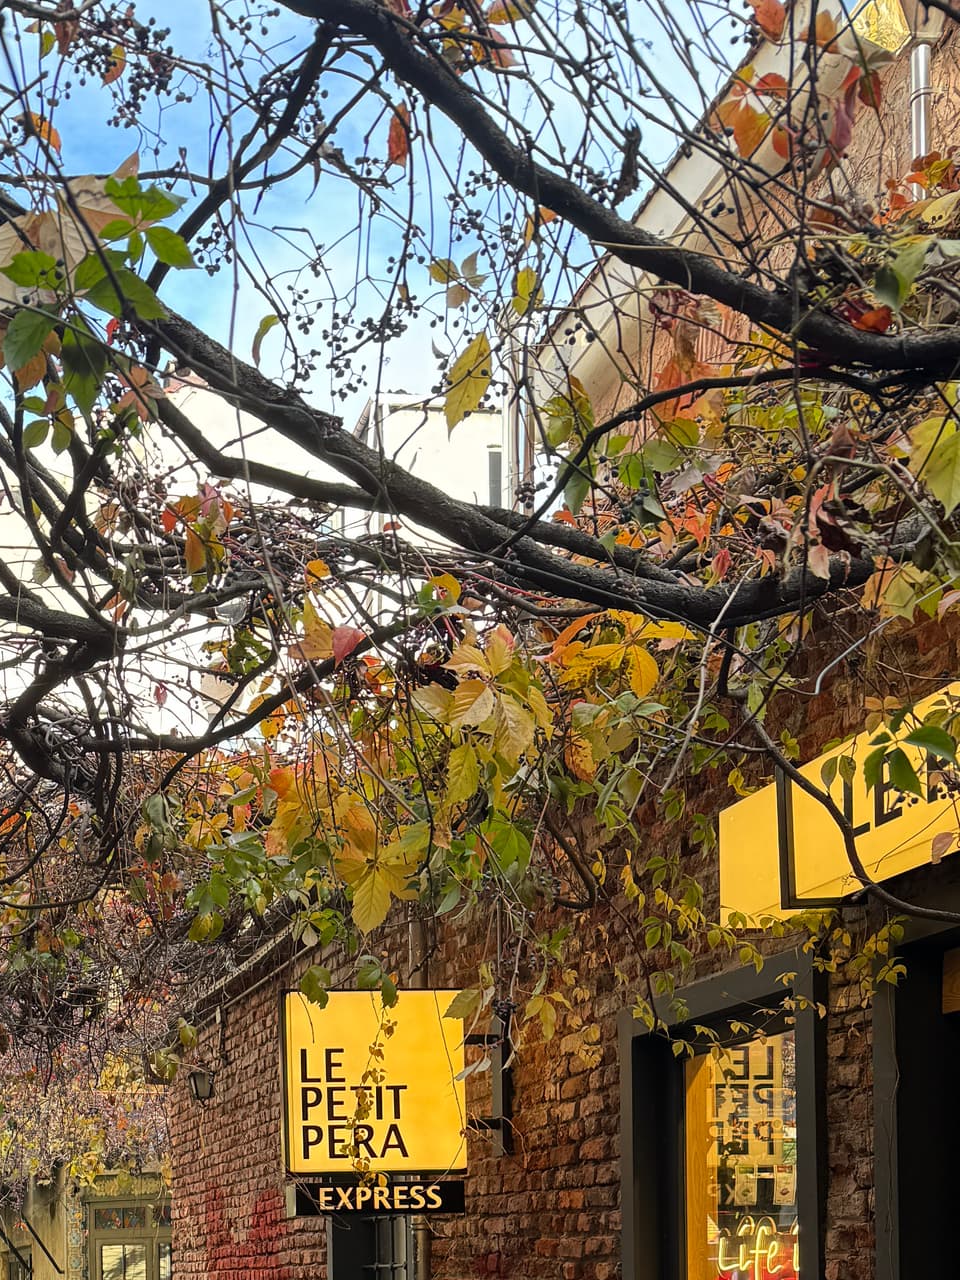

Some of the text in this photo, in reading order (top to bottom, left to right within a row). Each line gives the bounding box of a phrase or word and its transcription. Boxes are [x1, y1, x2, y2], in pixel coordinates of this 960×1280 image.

[300, 1048, 346, 1083] LE
[302, 1085, 408, 1121] PETIT
[303, 1124, 409, 1159] PERA
[319, 1185, 443, 1211] EXPRESS
